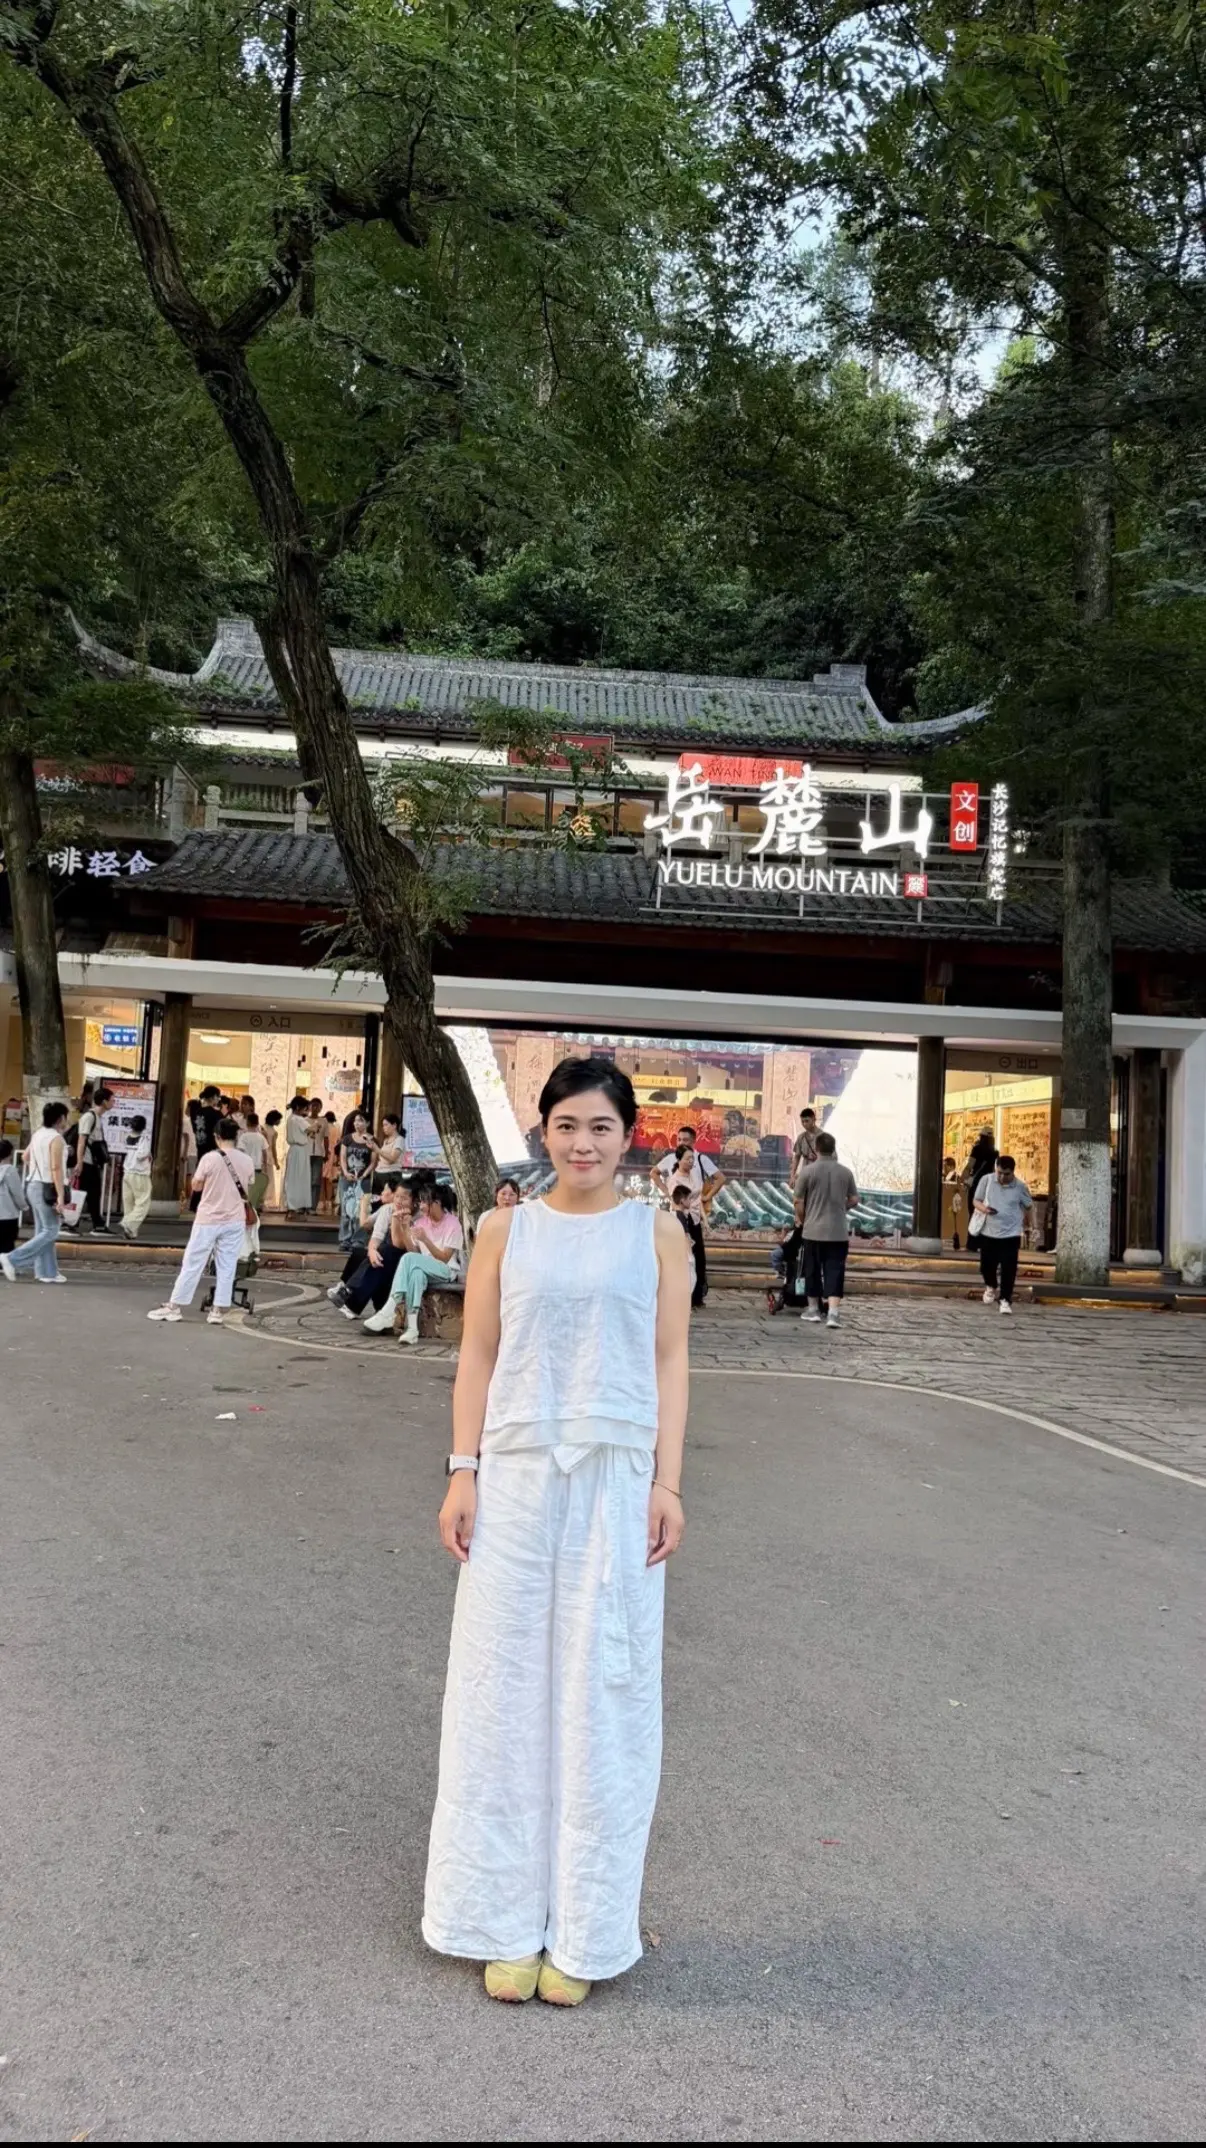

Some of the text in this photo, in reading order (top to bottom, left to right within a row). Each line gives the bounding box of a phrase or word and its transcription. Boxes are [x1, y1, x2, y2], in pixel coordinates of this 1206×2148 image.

[643, 763, 934, 859] 岳麓山
[953, 790, 976, 842] 文创
[47, 846, 158, 878] 啡轻食
[657, 860, 743, 888] YUELU
[751, 865, 898, 896] MOUNTAIN
[268, 1015, 291, 1029] 入口
[1017, 1057, 1038, 1069] 出口
